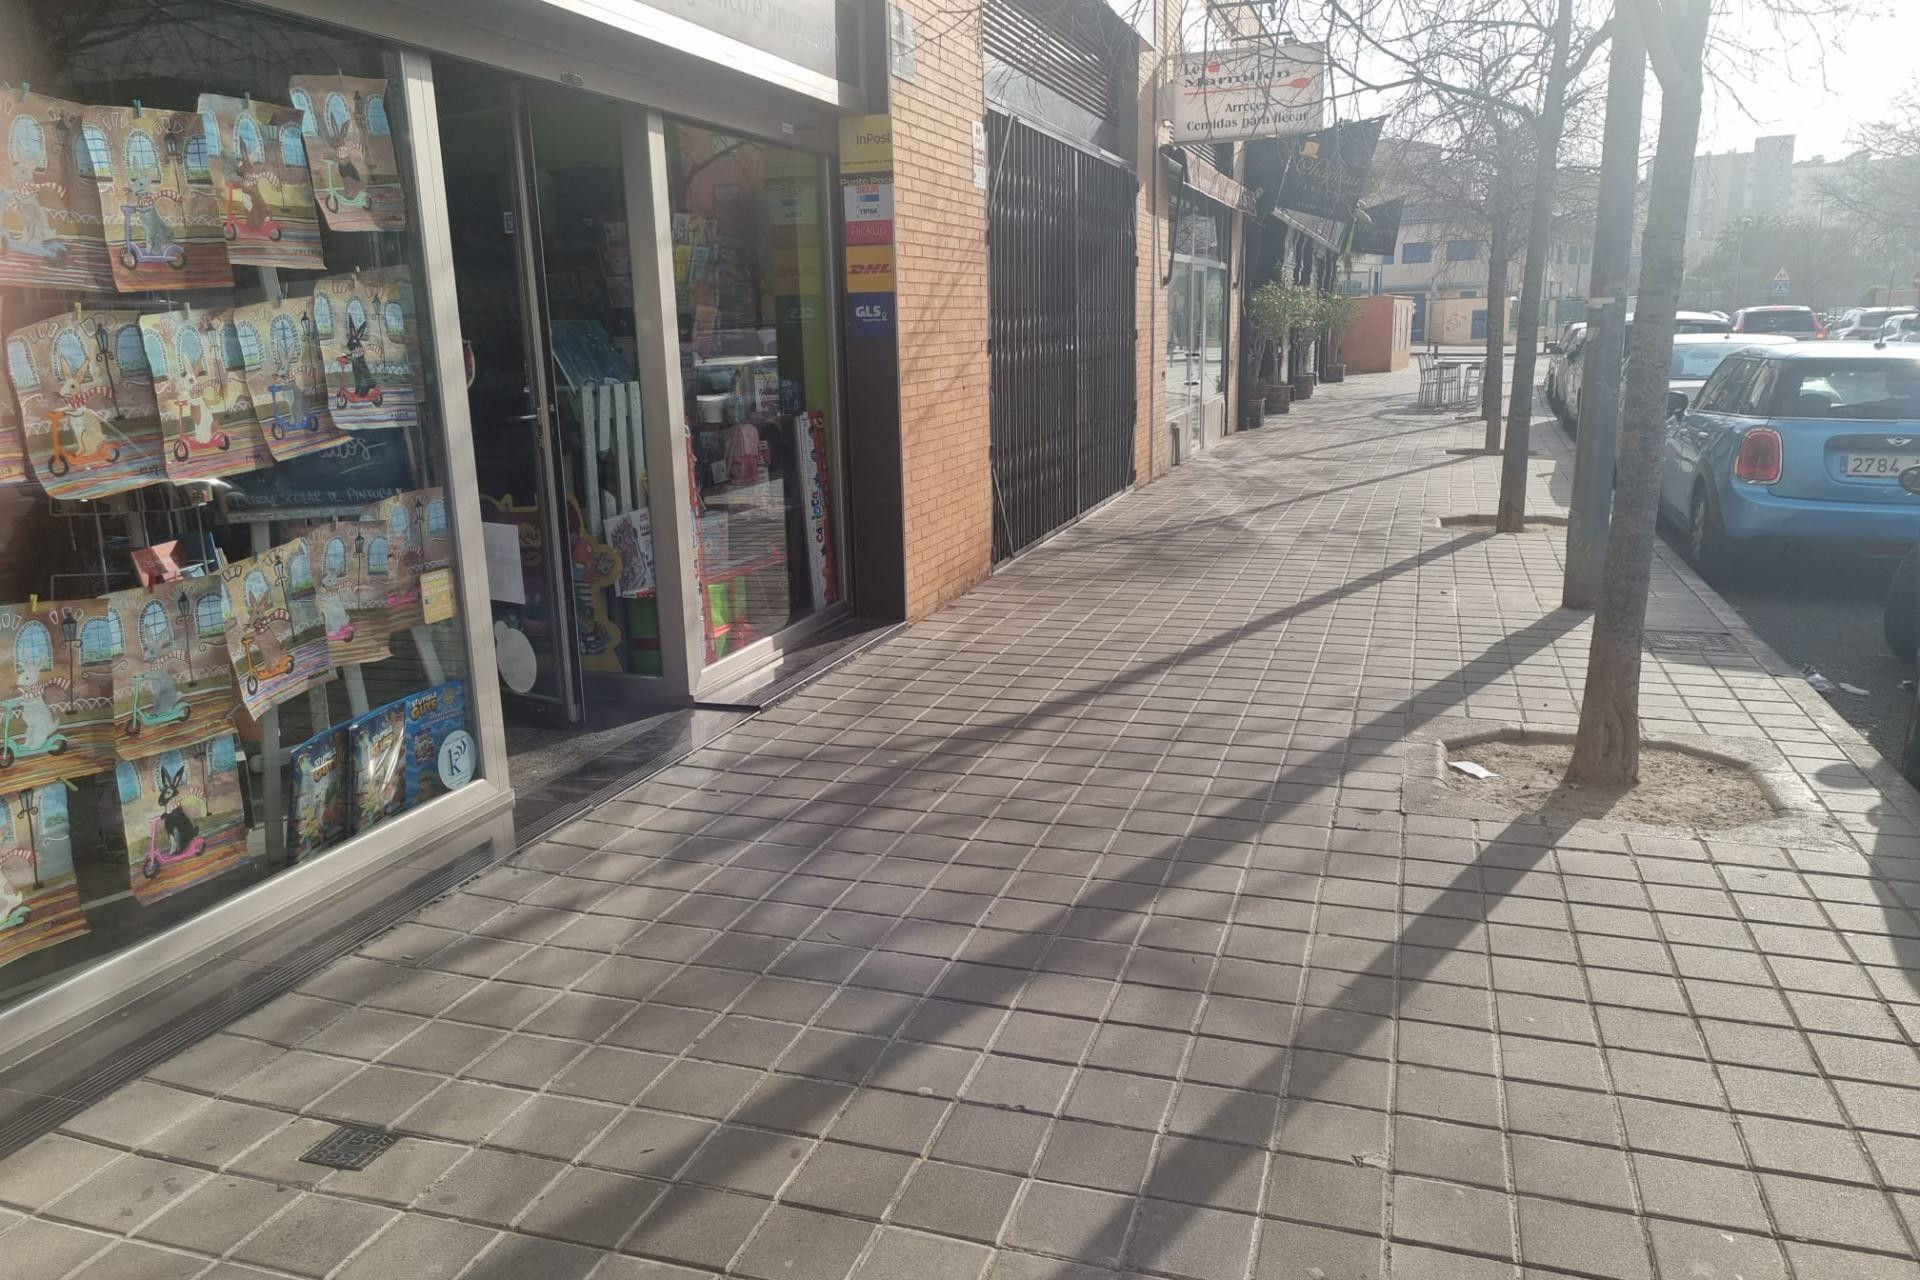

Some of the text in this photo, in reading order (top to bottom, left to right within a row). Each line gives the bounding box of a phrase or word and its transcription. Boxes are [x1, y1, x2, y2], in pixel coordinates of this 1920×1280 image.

[1184, 64, 1200, 75] Le
[1187, 118, 1238, 131] Comidas
[1242, 115, 1270, 128] para
[859, 207, 878, 215] TIPSA
[848, 263, 892, 275] DHL
[855, 305, 881, 318] GLS
[1852, 458, 1901, 473] 2784
[411, 698, 438, 721] GUYS
